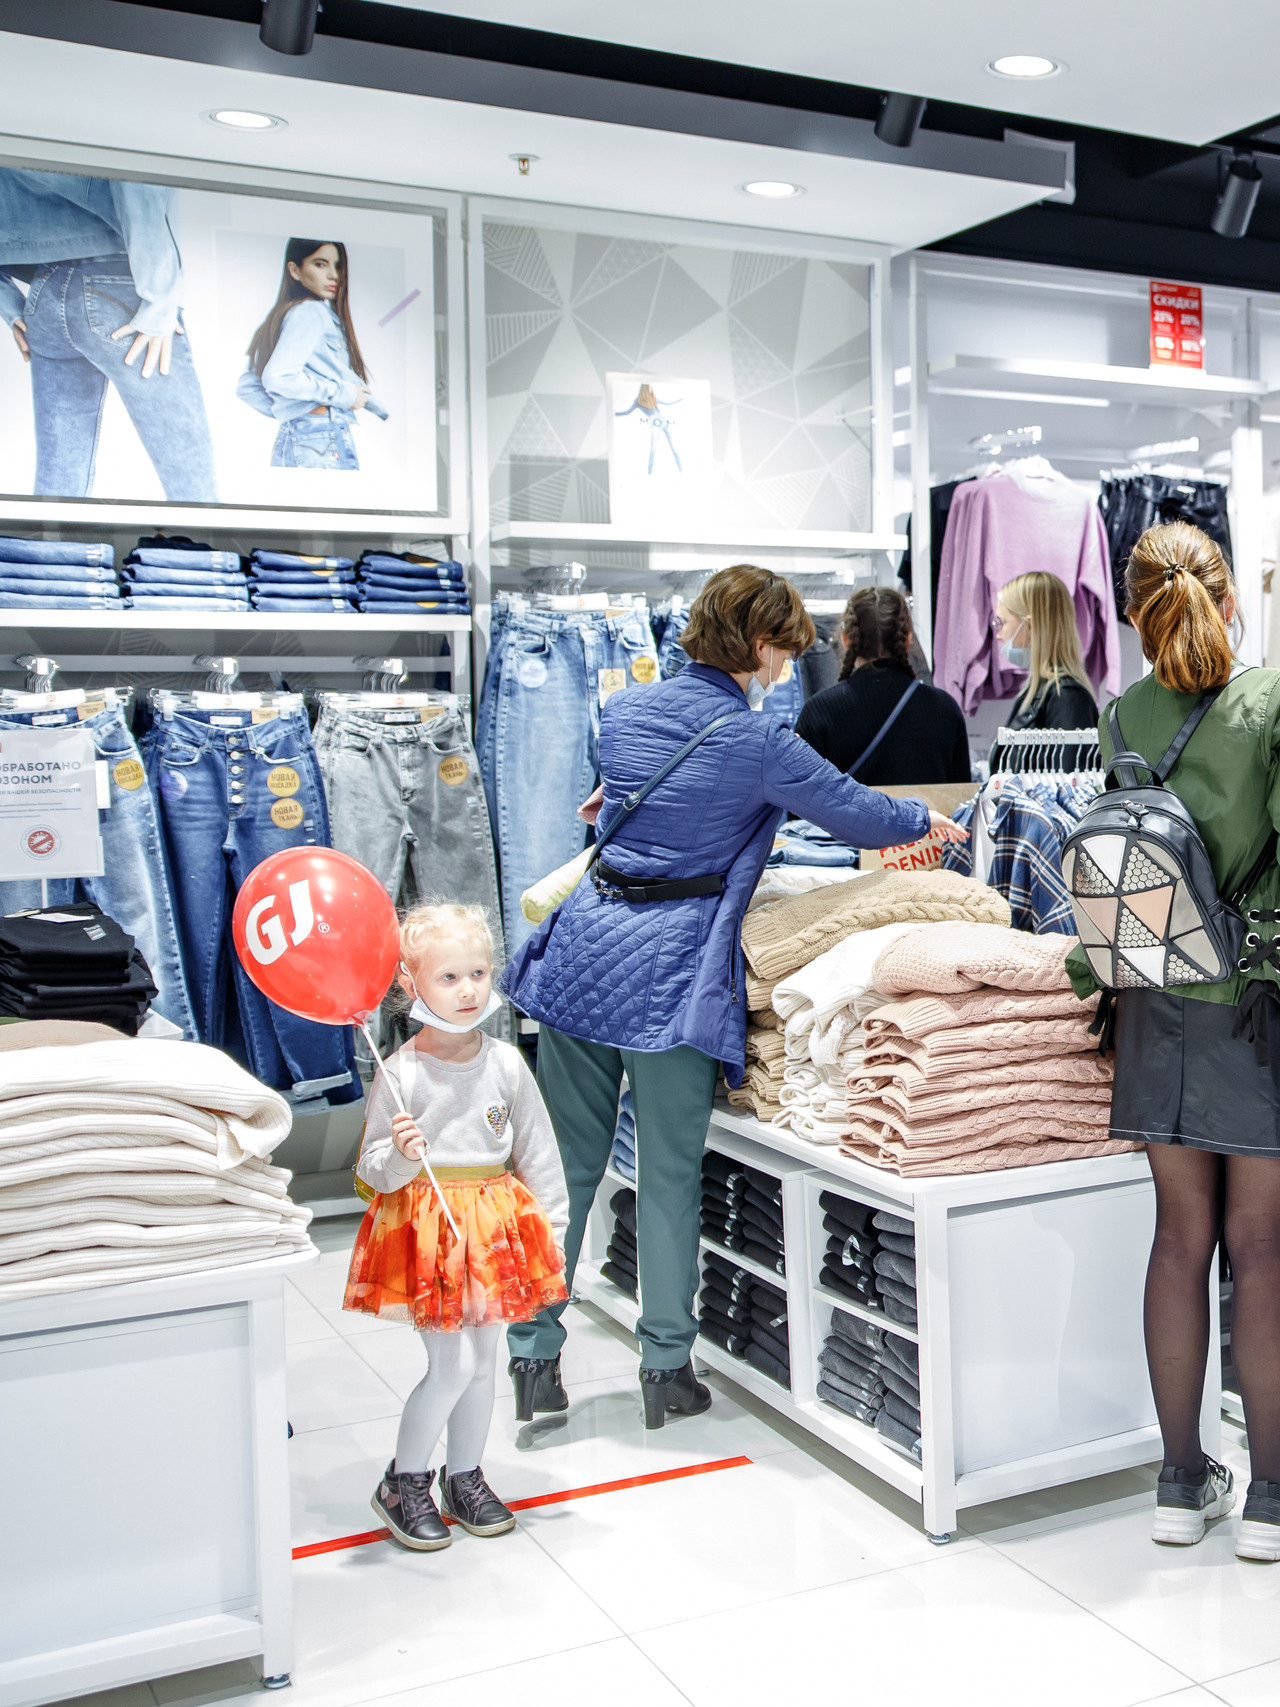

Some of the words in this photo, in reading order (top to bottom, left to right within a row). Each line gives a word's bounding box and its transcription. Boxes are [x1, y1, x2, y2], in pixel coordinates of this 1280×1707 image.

[0, 761, 81, 773] БРАБОТАНО
[115, 763, 140, 777] НОВАЯ
[441, 762, 464, 773] НОВАЯ
[271, 772, 296, 782] НОВАЯ
[274, 804, 299, 816] НОВАЯ
[245, 879, 314, 965] GJ
